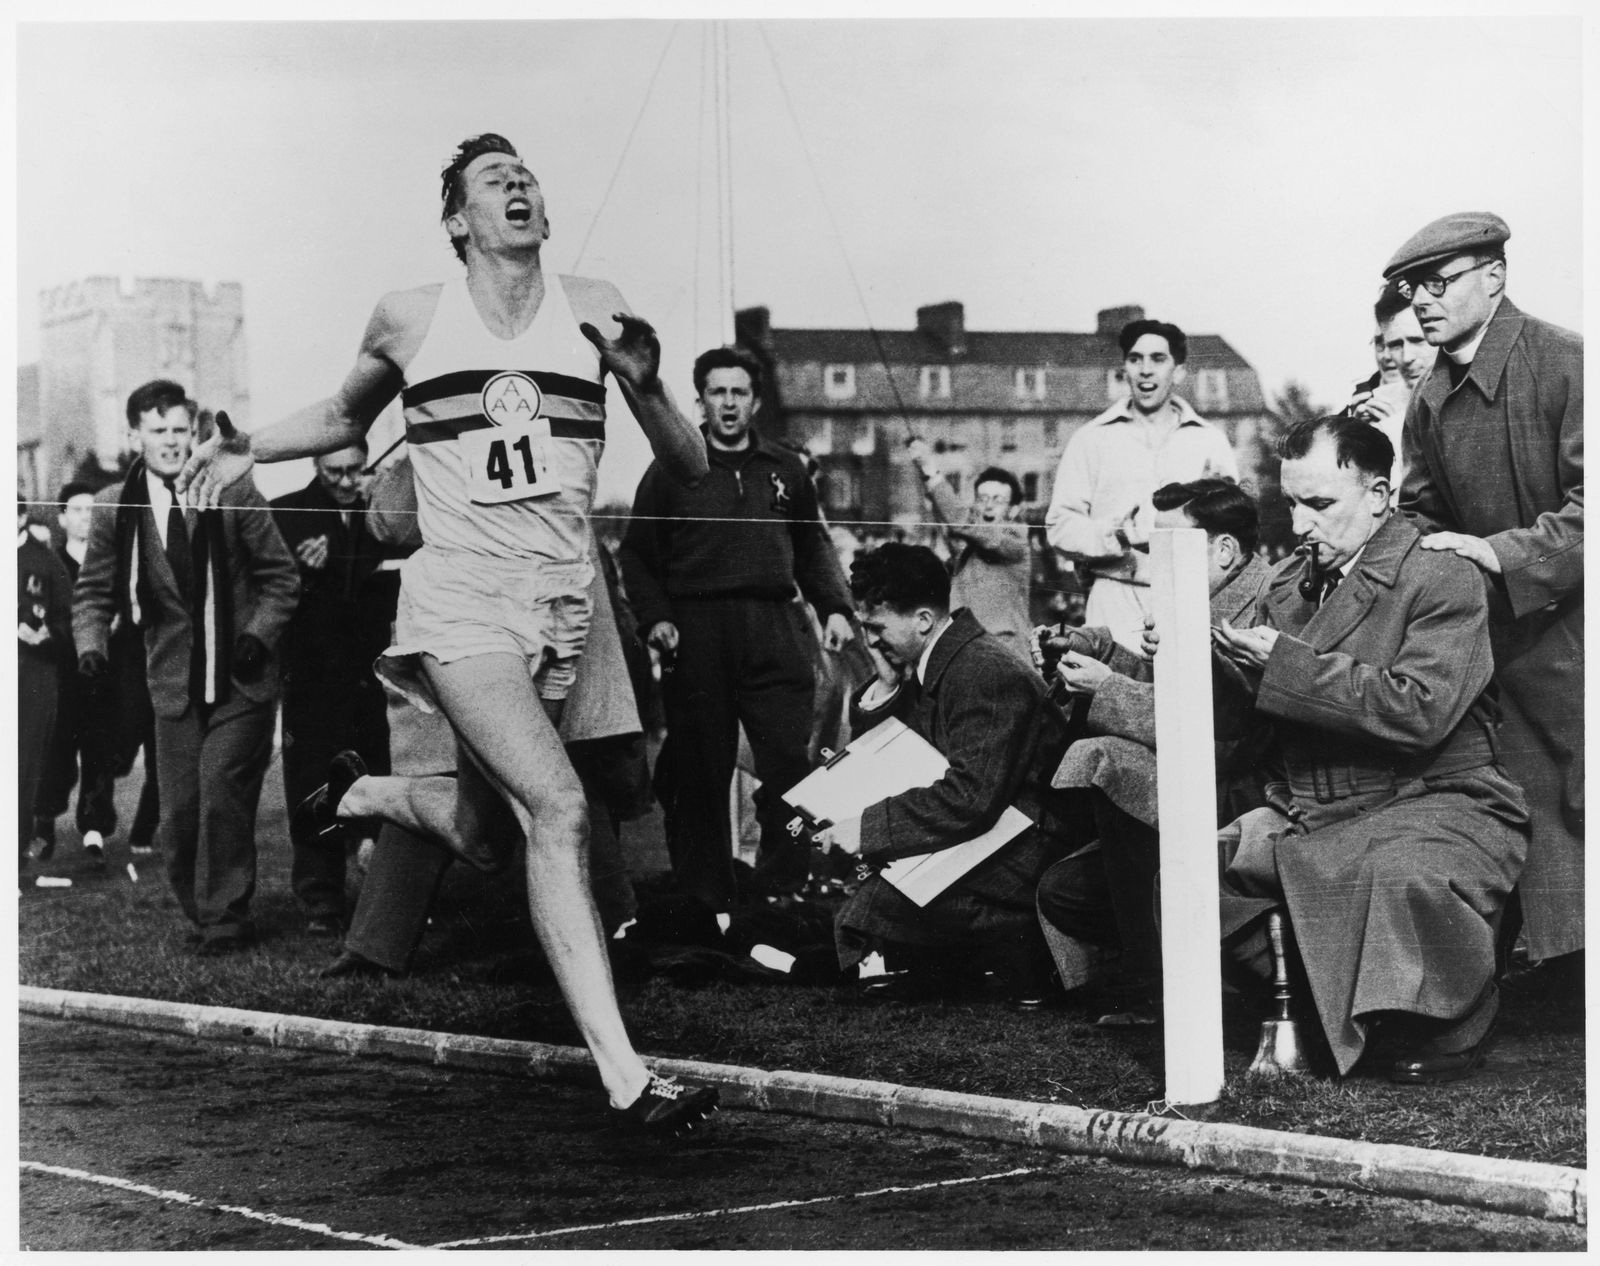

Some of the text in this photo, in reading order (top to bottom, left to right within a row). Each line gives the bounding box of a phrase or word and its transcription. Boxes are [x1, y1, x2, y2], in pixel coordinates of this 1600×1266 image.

[502, 379, 520, 396] A
[491, 398, 532, 412] A A
[486, 435, 537, 489] 41
